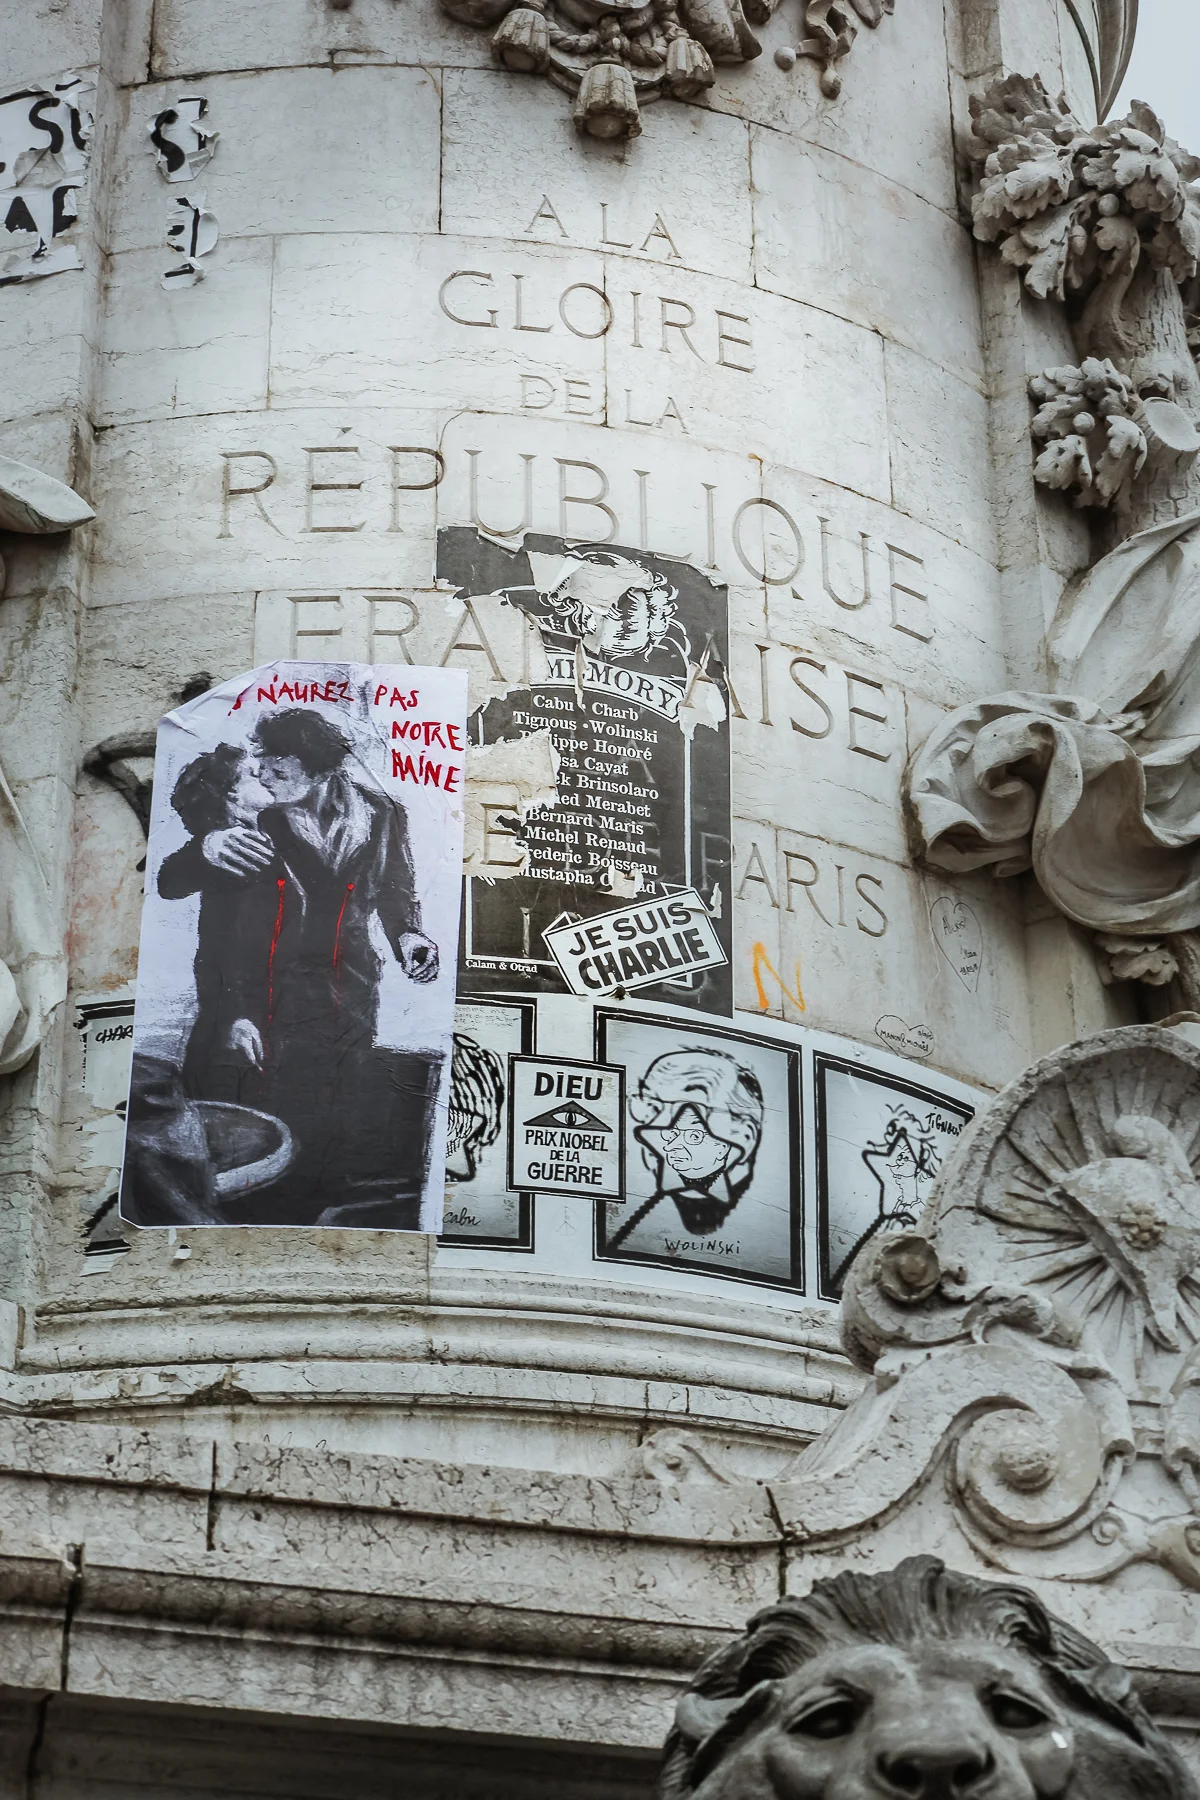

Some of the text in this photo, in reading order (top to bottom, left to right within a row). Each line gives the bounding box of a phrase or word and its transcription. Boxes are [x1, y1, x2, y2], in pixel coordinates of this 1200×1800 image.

[523, 193, 682, 259] A LA
[438, 270, 755, 374] GLOIRE
[519, 373, 690, 434] DE LA
[374, 684, 420, 711] PAS
[533, 695, 639, 722] Cabu Charb
[392, 720, 464, 751] NOTRE
[512, 711, 659, 744] Tignous Wolinski
[593, 739, 653, 761] Honoré
[584, 756, 629, 776] Cayat
[576, 774, 659, 800] Brinsolaro
[586, 795, 651, 817] Merabet
[527, 808, 644, 835] Bernard Maris
[524, 826, 647, 855] Michel Renaud
[588, 852, 658, 875] Boisseau
[568, 924, 612, 956] JE
[612, 902, 692, 941] SUIS
[465, 959, 497, 970] Calam
[510, 962, 538, 973] Otrad
[577, 927, 711, 990] CHARLIE
[534, 1071, 603, 1101] DIEU
[525, 1129, 608, 1152] PRIX NOBEL
[550, 1150, 580, 1163] DE LA
[527, 1161, 603, 1185] GUERRE
